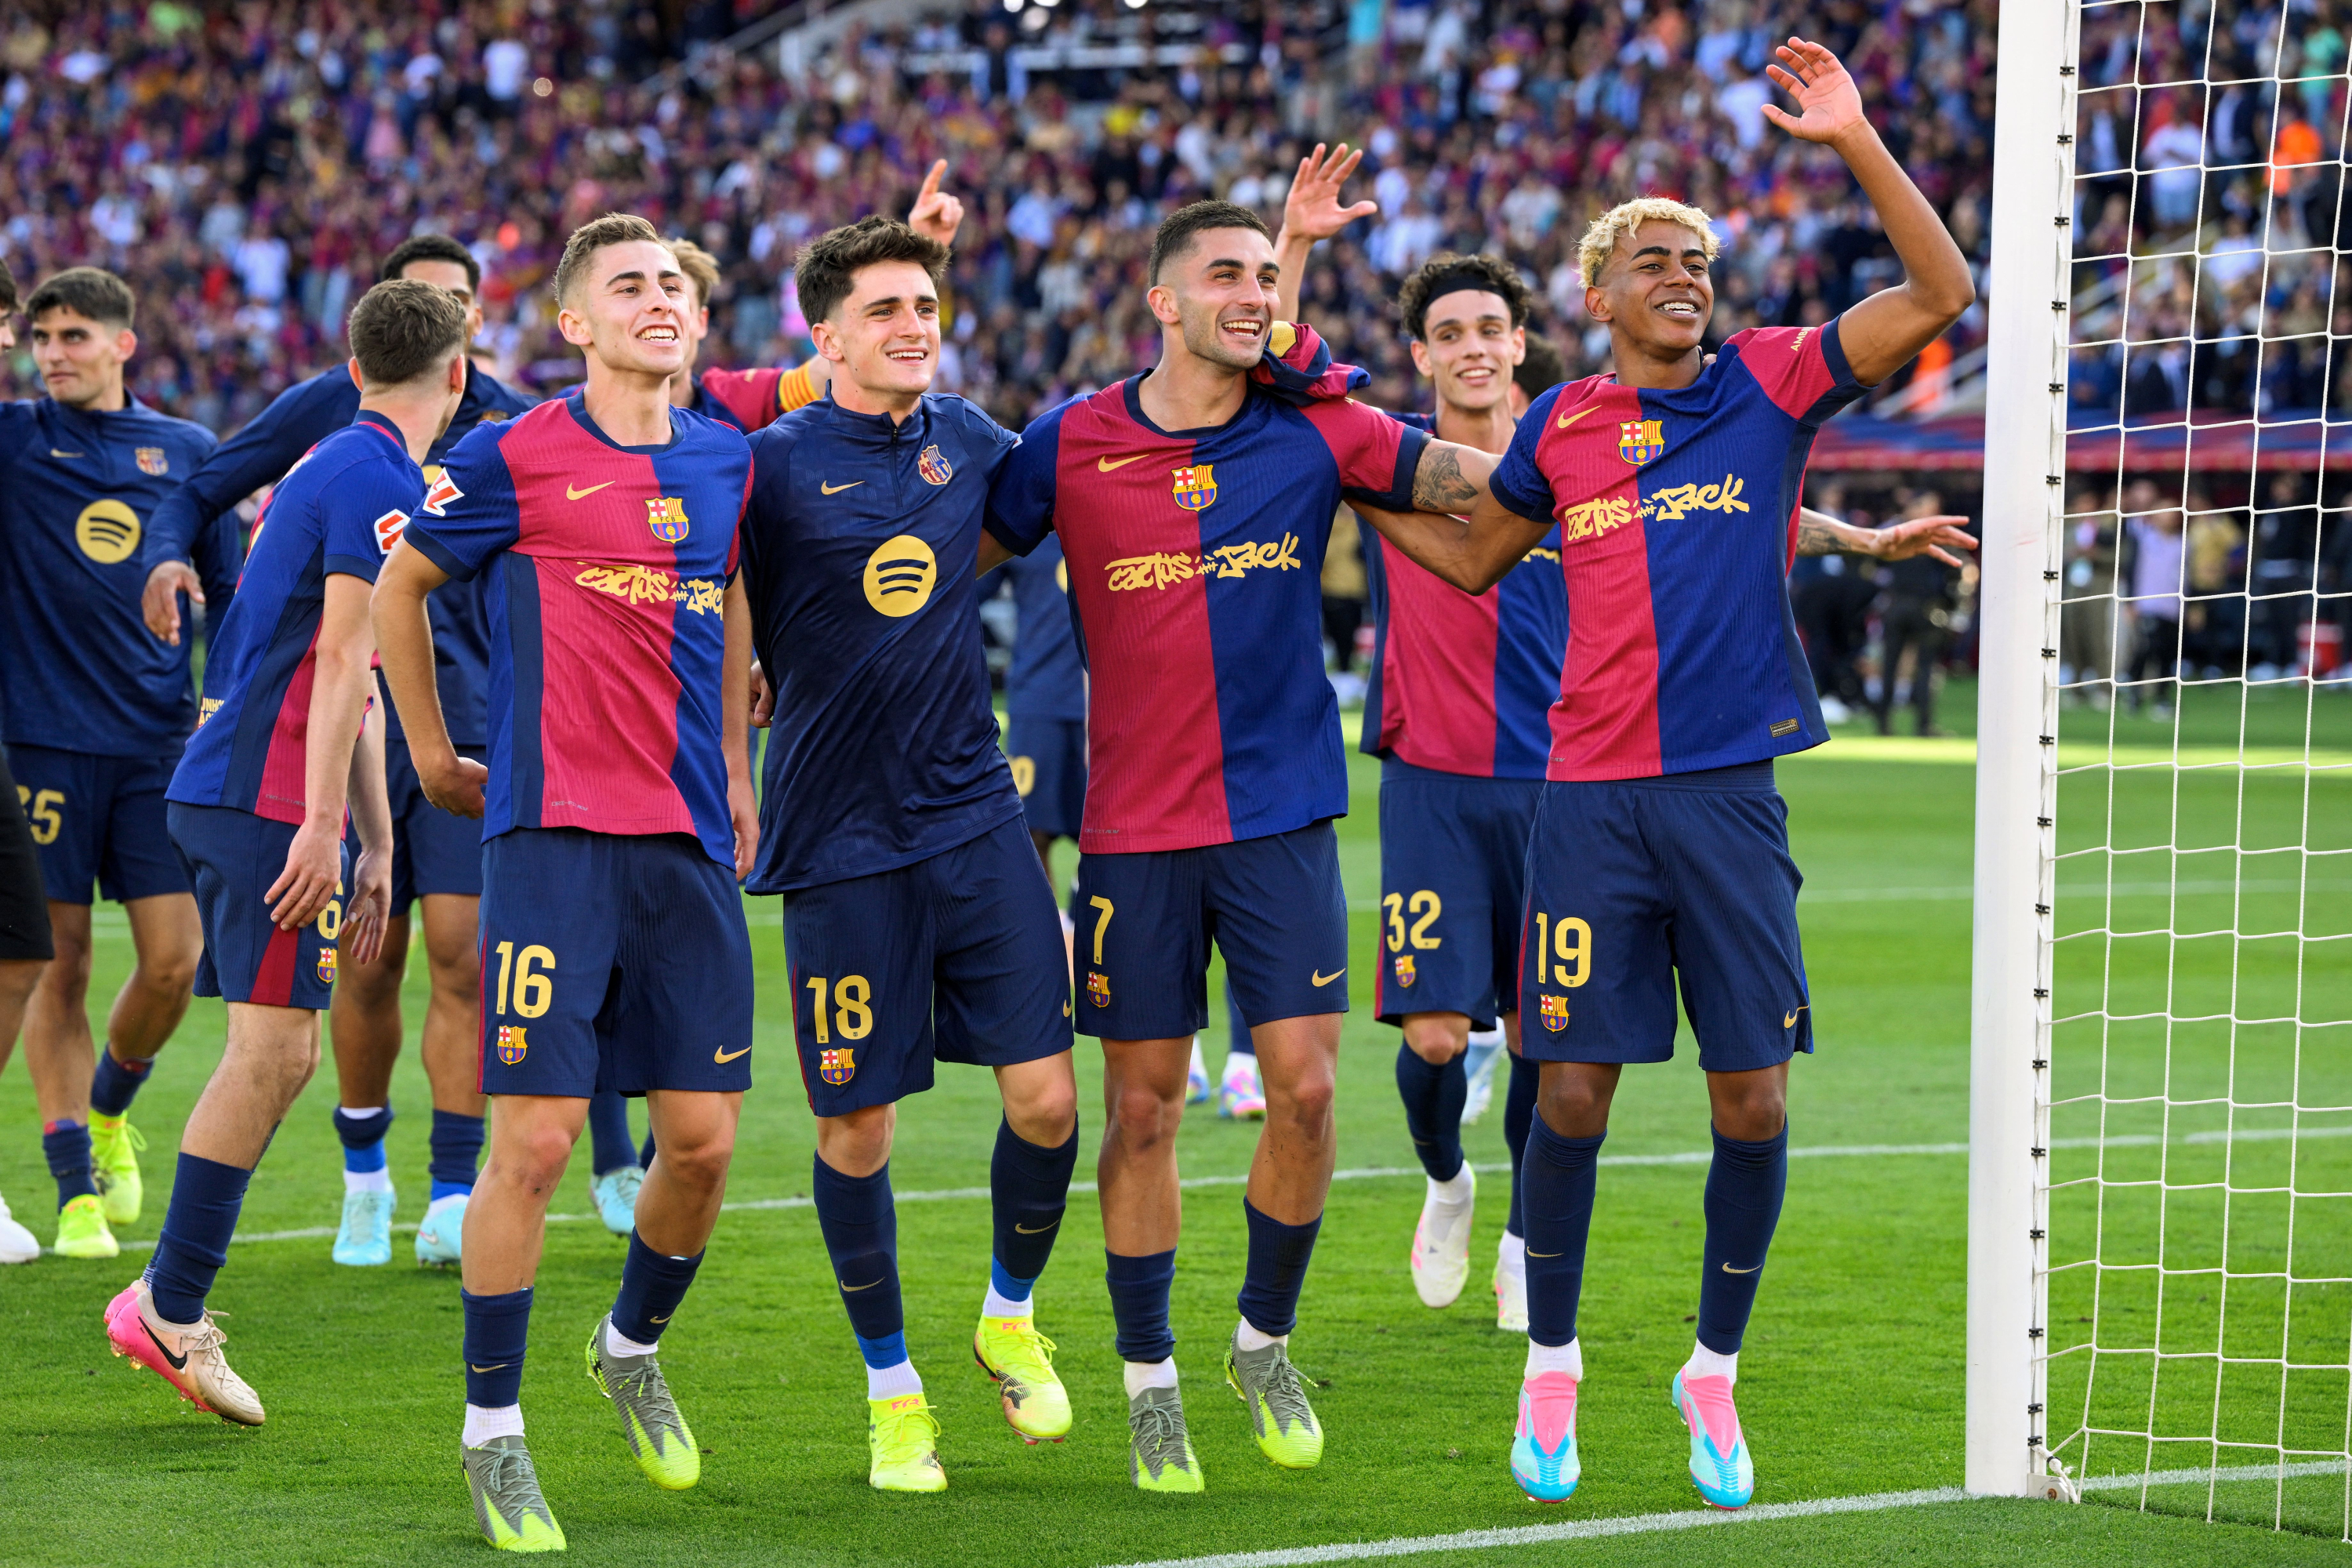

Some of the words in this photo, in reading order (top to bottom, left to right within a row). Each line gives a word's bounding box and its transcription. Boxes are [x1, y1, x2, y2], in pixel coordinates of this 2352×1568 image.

[687, 578, 727, 622] Jac
[1006, 753, 1036, 798] 0
[1089, 895, 1115, 965] 7
[1382, 889, 1443, 953] 32
[1535, 912, 1592, 989] 19
[495, 941, 556, 1018] 16
[806, 975, 873, 1044] 18
